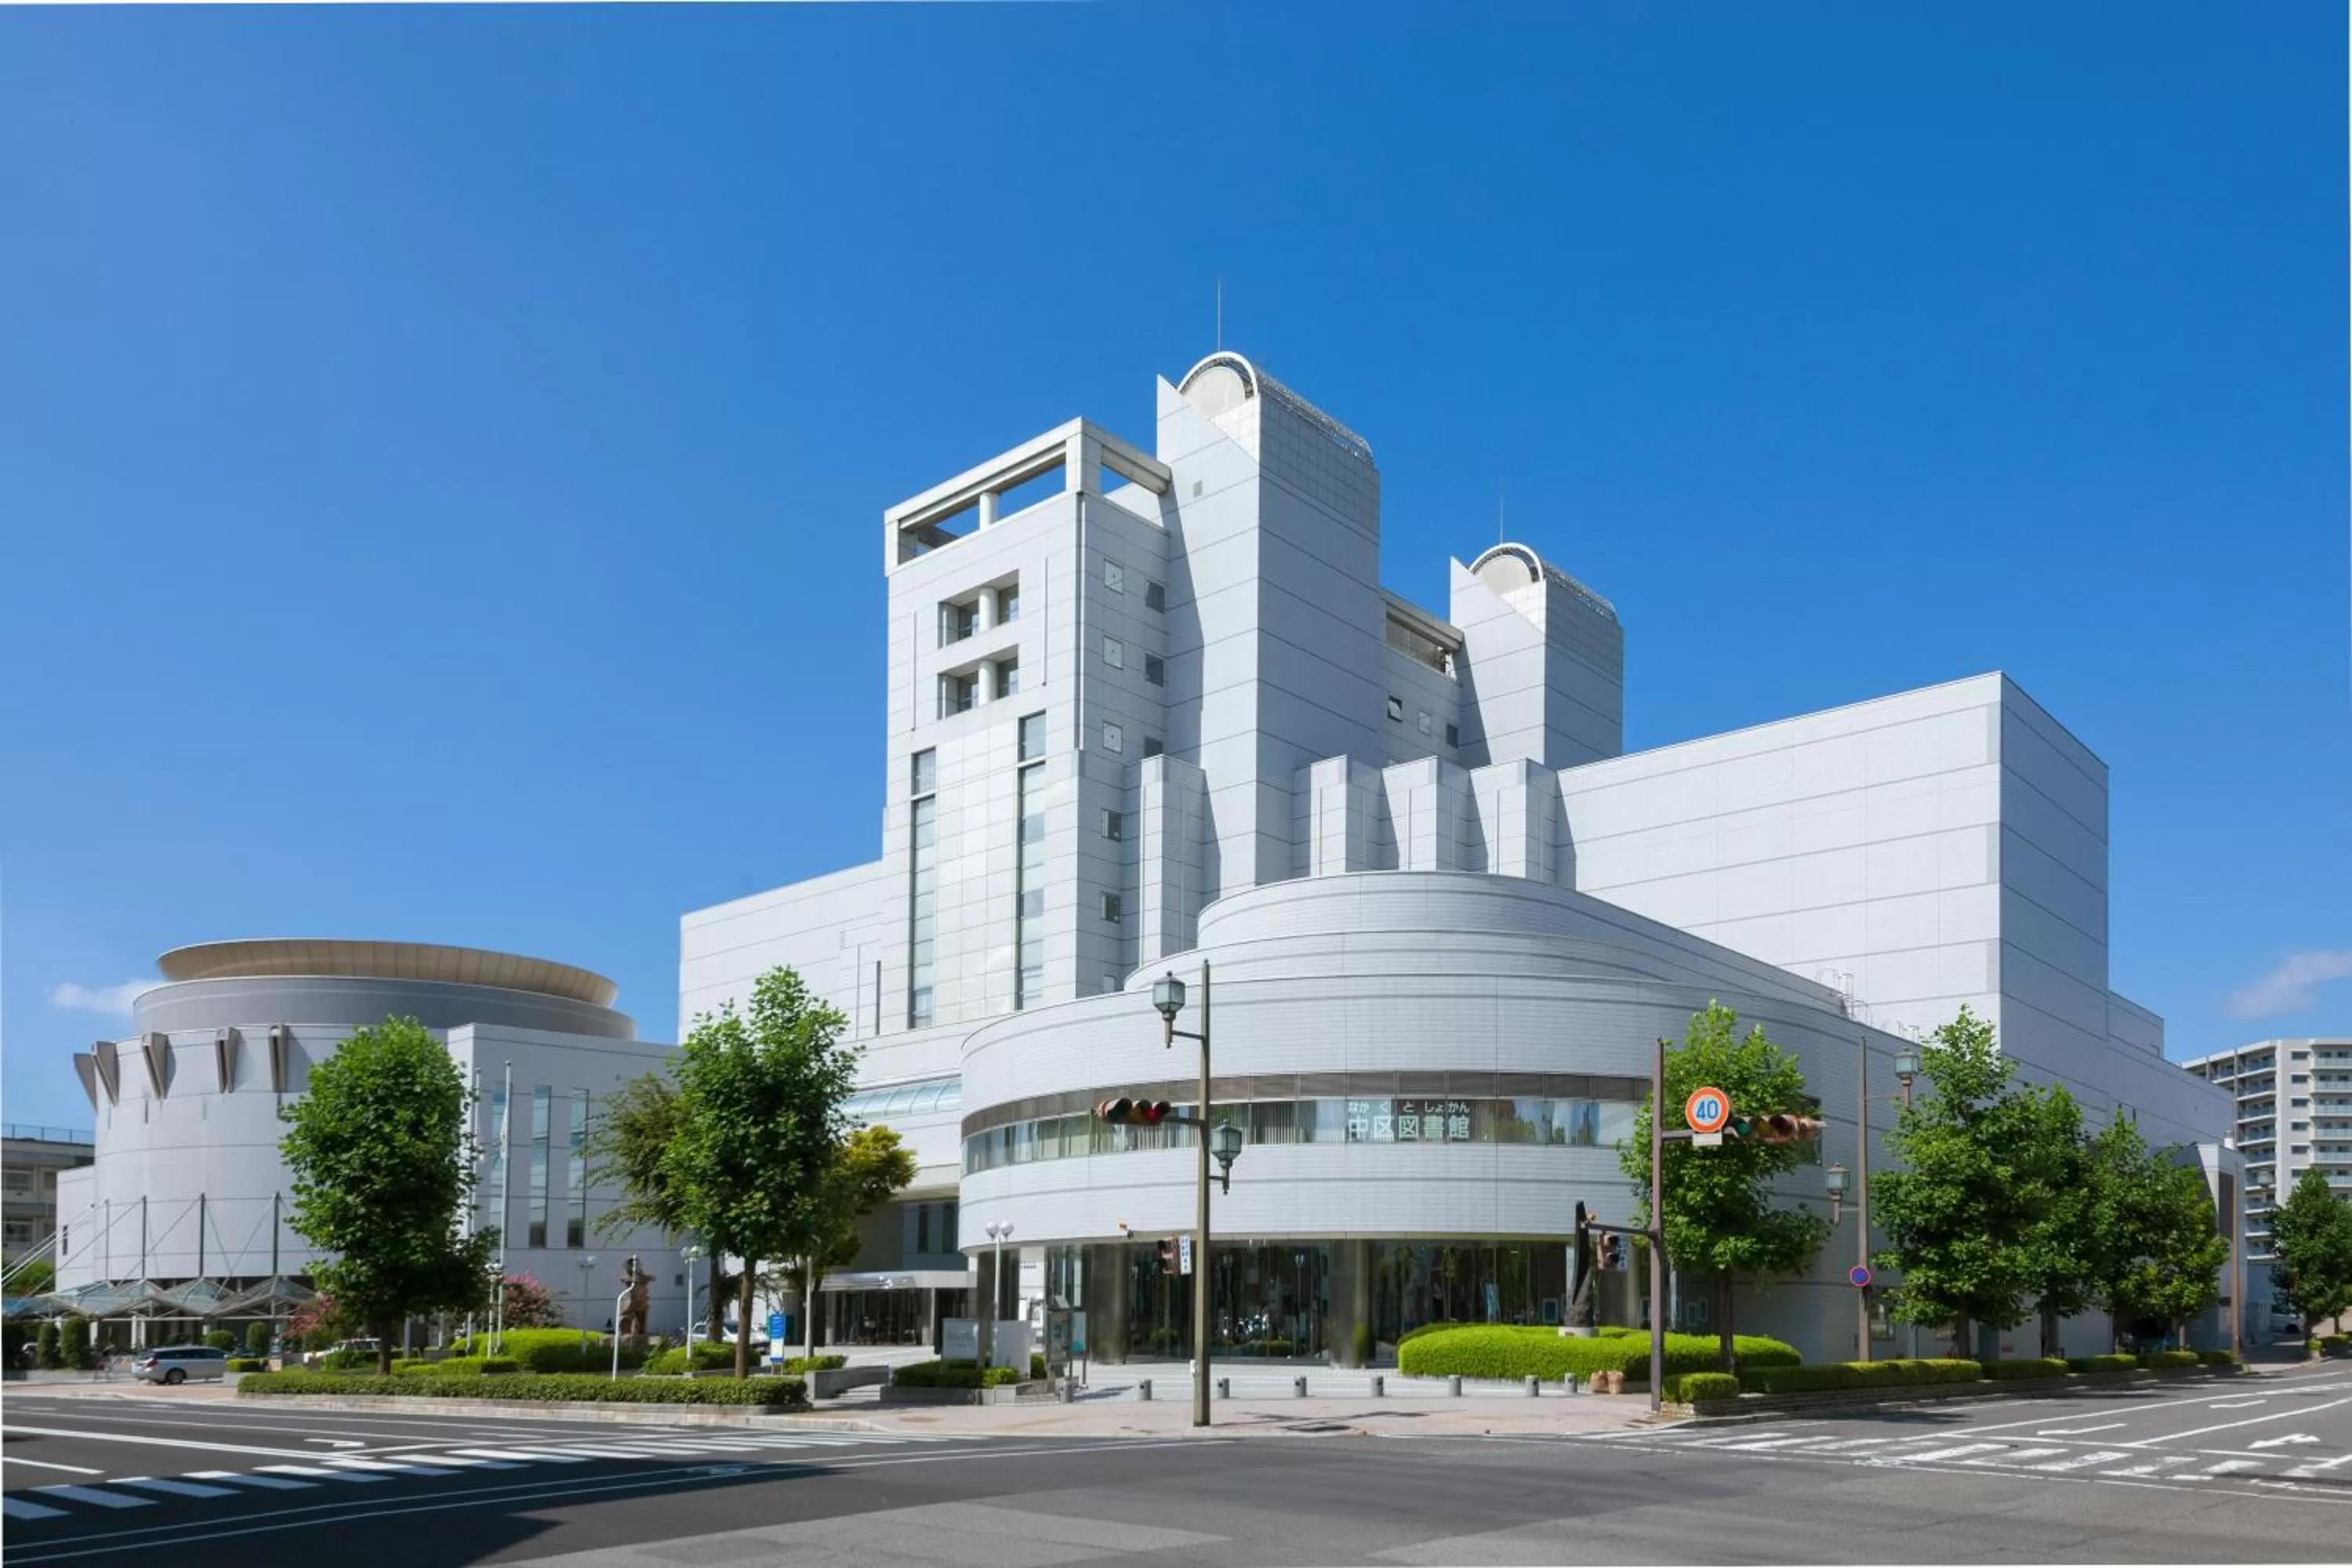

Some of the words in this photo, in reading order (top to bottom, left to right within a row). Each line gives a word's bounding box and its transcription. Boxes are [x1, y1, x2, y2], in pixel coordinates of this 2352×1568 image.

[1697, 1100, 1718, 1120] 40
[1348, 1115, 1470, 1139] 中区図書館
